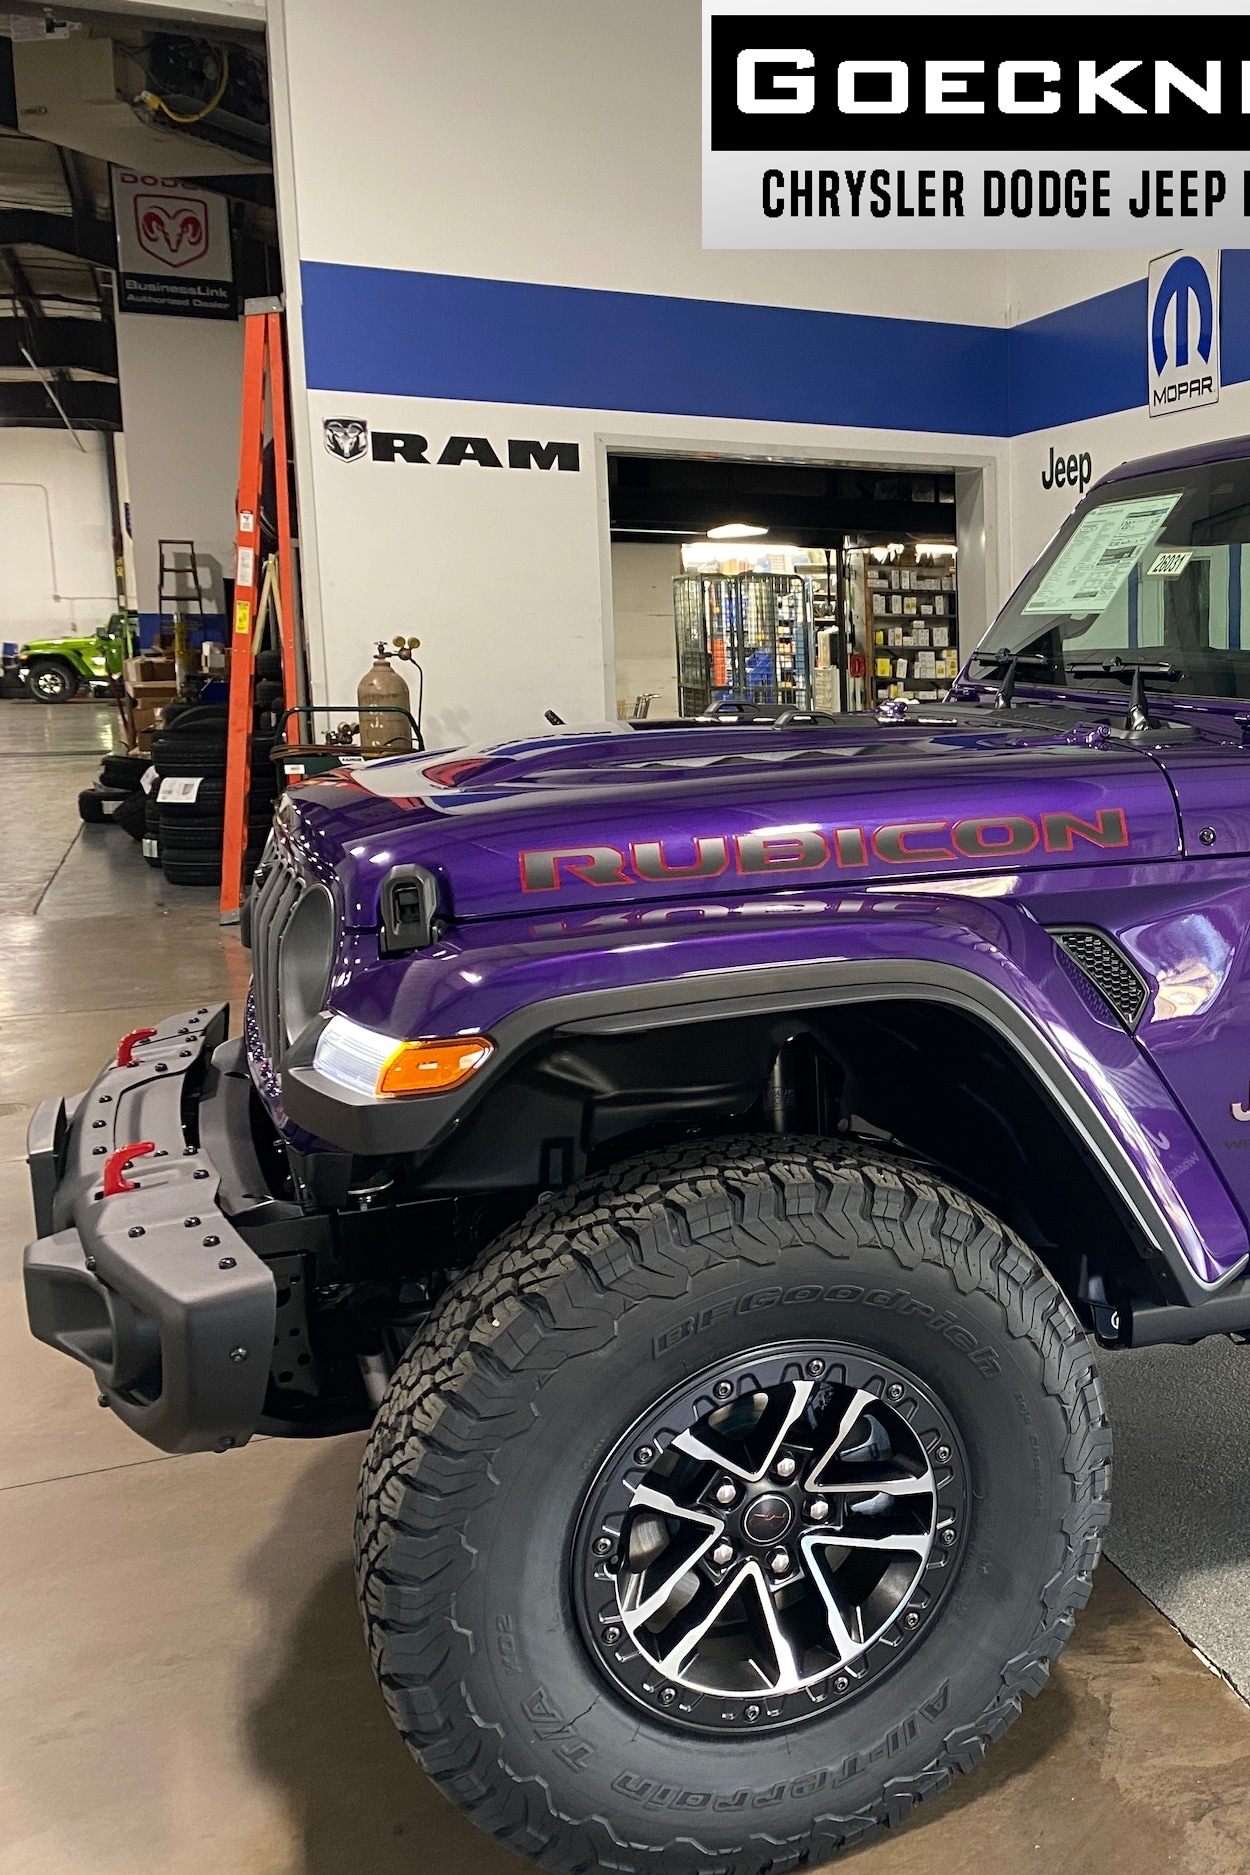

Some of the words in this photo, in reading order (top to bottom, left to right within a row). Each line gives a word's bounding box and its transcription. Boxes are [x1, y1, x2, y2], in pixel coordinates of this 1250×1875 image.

[125, 280, 227, 298] BusinessLink
[1153, 376, 1214, 406] MOPAR
[371, 431, 580, 472] RAM
[1042, 447, 1092, 494] Jeep
[1152, 554, 1184, 573] 26031
[520, 809, 1130, 893] RUBICON
[653, 1284, 1003, 1380] BFGoodrich
[611, 1677, 950, 1812] All-Terrain
